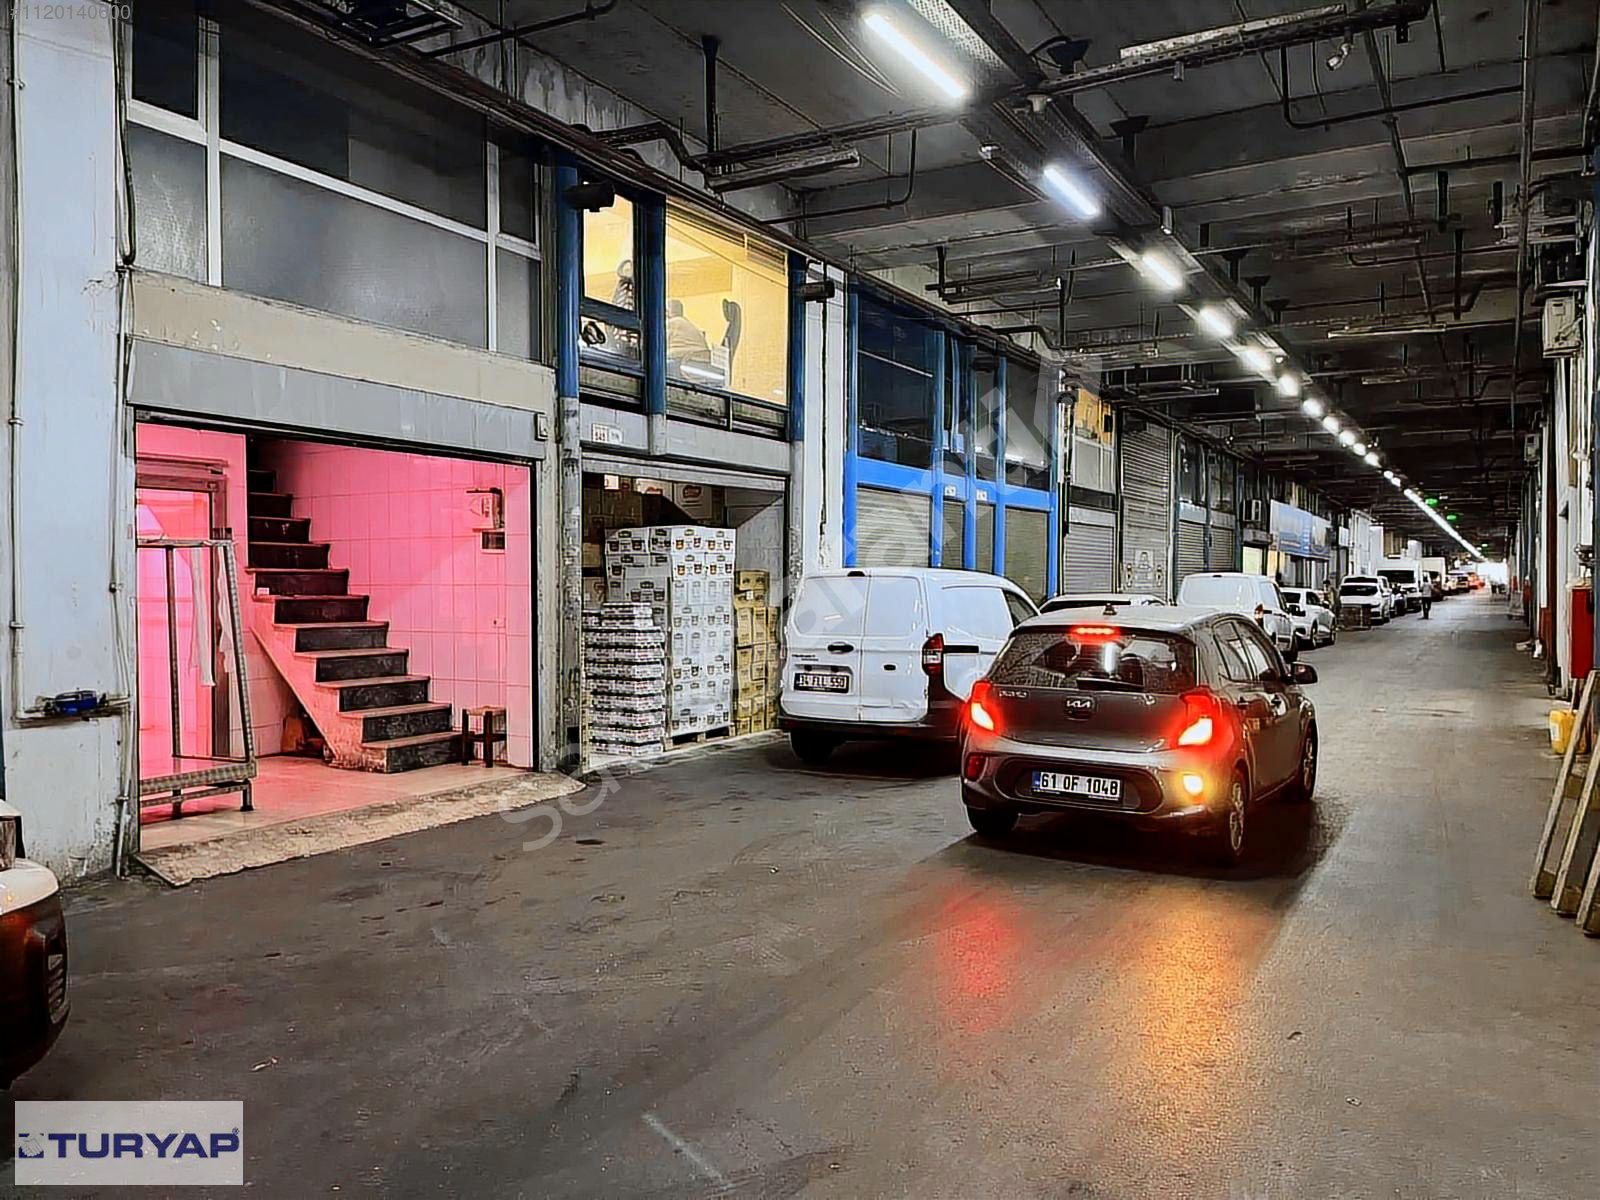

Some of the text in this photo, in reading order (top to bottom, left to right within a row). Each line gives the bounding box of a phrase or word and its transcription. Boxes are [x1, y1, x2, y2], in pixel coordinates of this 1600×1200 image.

[1041, 773, 1118, 795] 61 OF 1048
